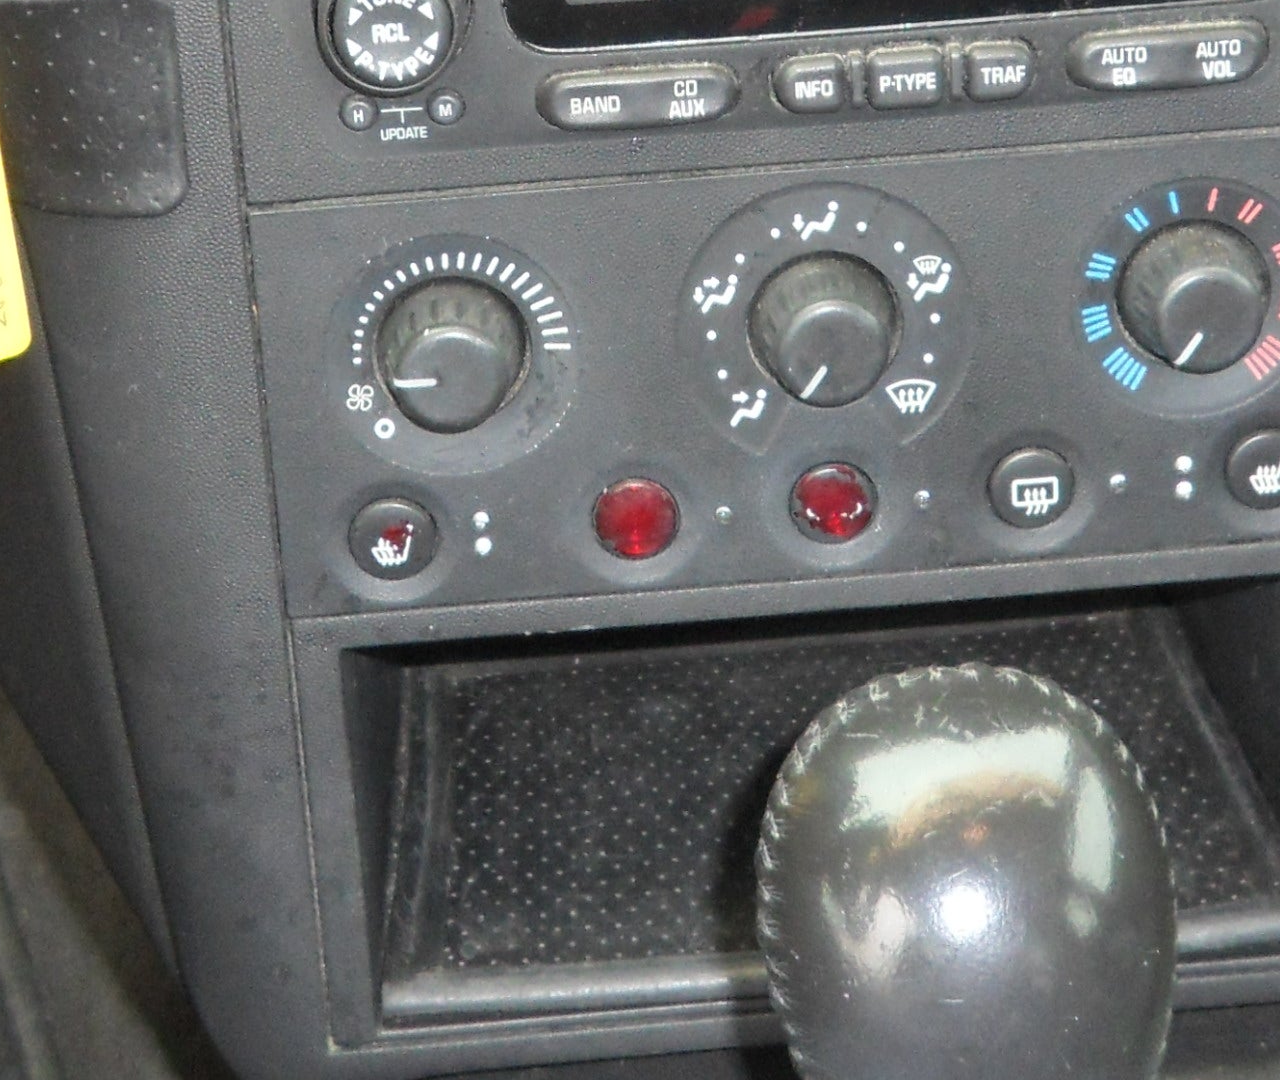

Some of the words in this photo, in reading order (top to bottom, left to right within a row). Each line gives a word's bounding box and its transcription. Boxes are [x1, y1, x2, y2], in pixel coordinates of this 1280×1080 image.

[371, 22, 410, 45] RCL
[1101, 46, 1148, 66] AUTO
[1195, 38, 1242, 59] AUTO
[980, 65, 1027, 86] TRAF
[1112, 67, 1137, 87] EQ
[1202, 59, 1236, 81] VOL
[673, 79, 698, 98] CD
[794, 79, 834, 100] INFO
[879, 71, 938, 94] P-TYPE
[352, 107, 365, 124] H
[438, 102, 454, 118] M
[570, 95, 621, 115] BAND
[669, 99, 706, 119] AUX
[379, 125, 429, 141] UPDATE
